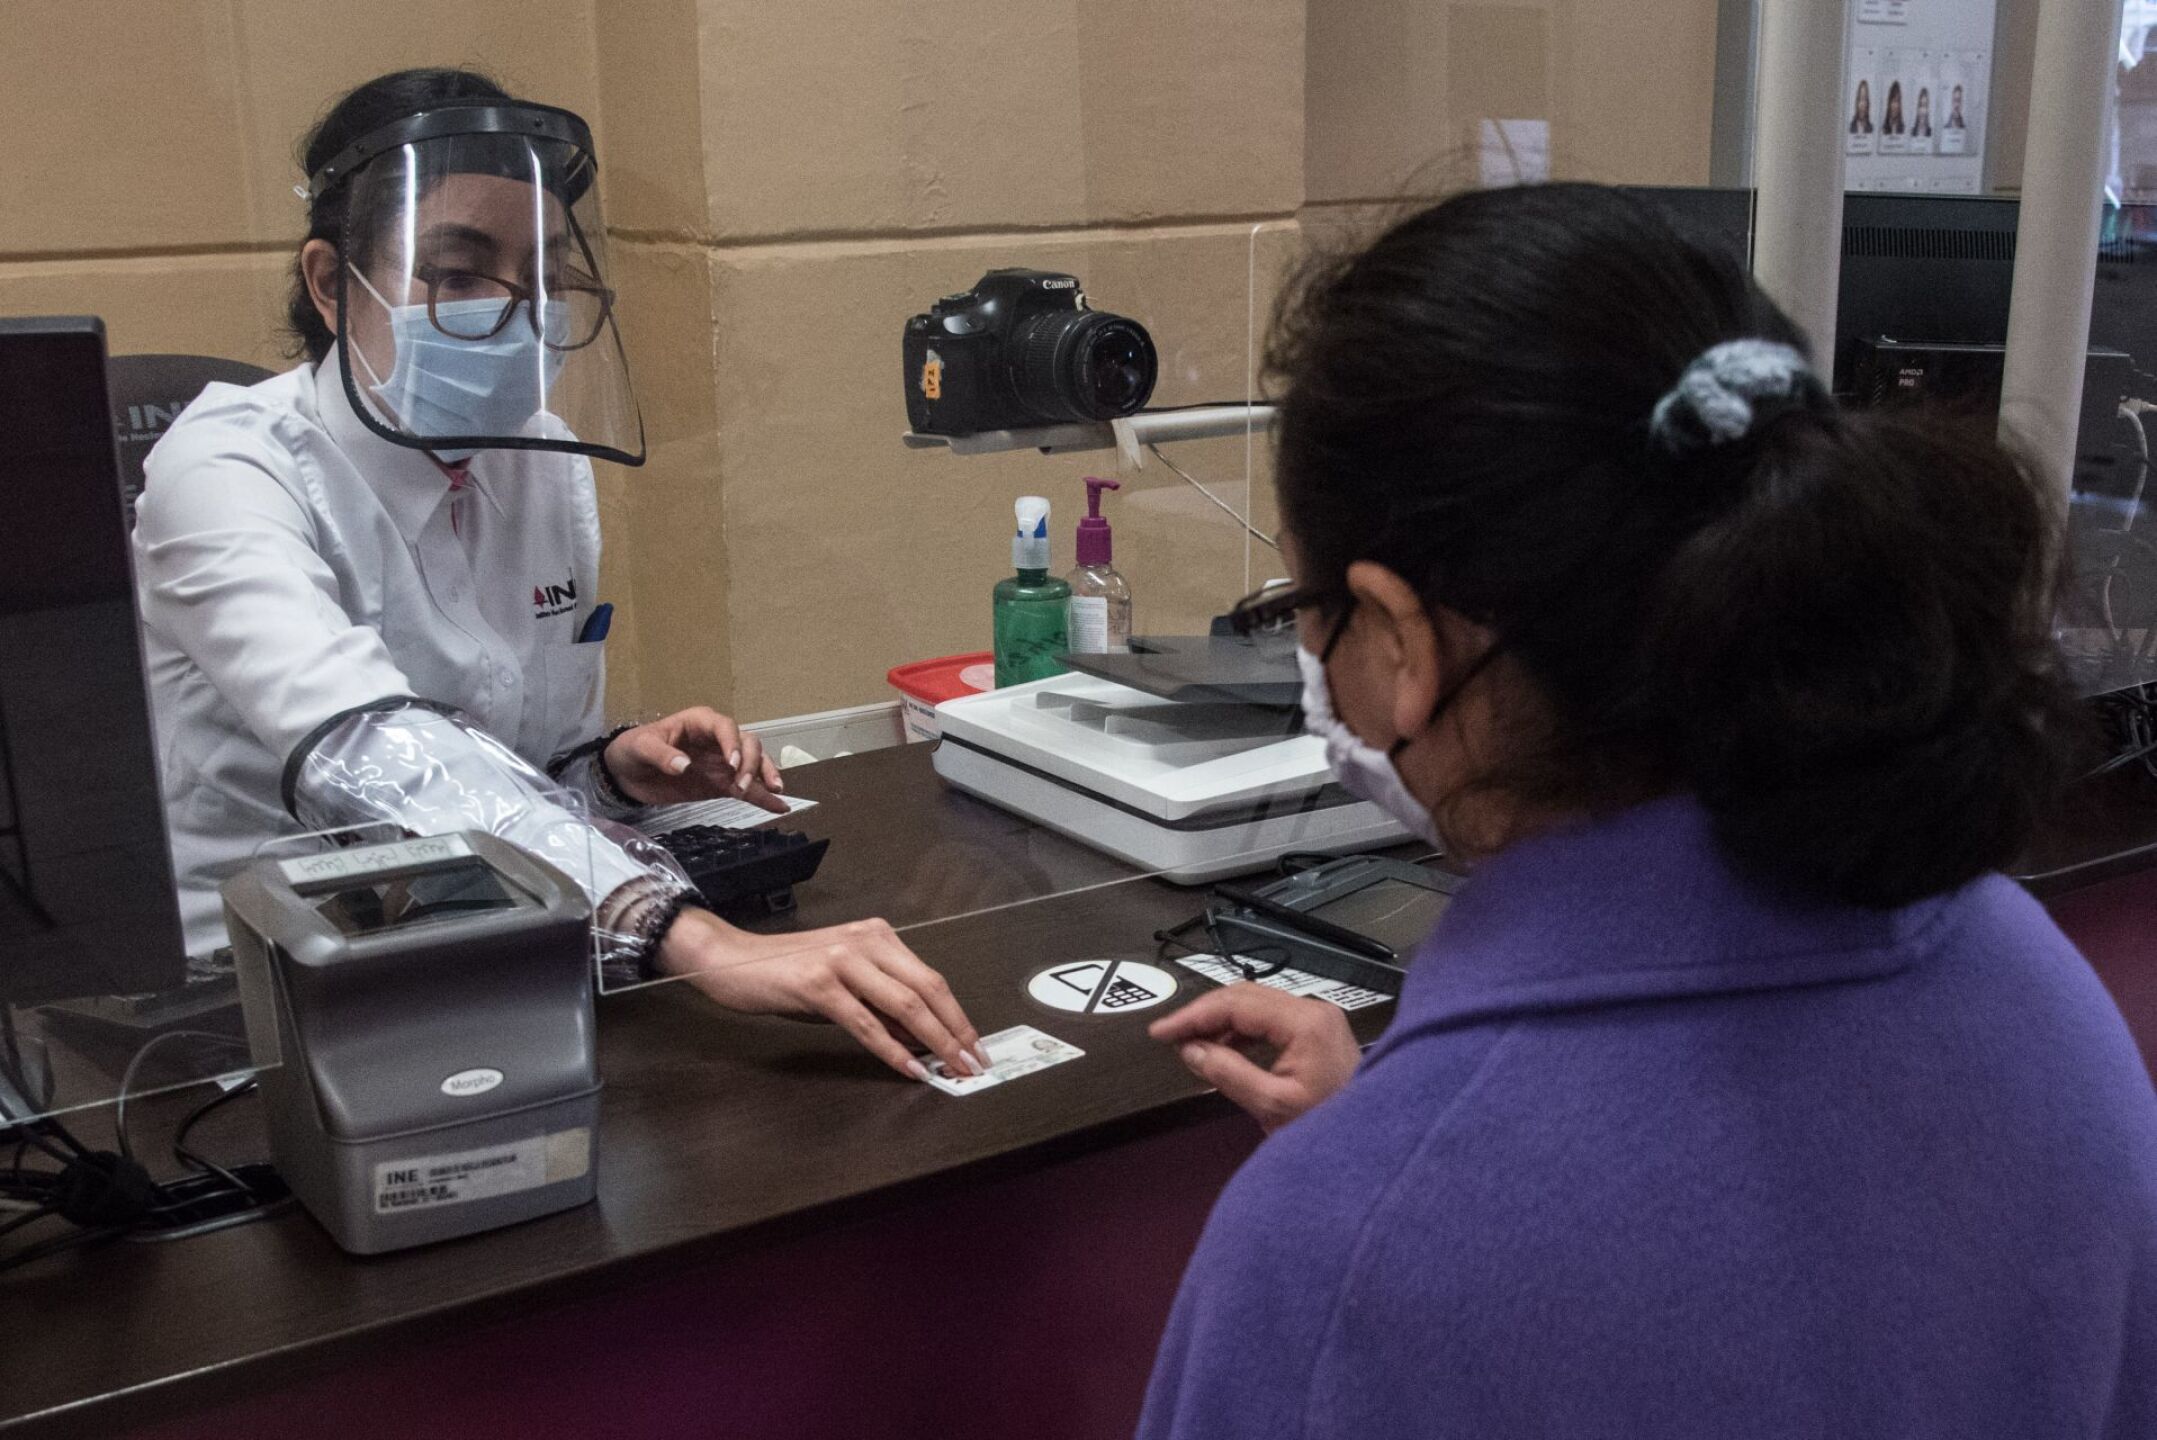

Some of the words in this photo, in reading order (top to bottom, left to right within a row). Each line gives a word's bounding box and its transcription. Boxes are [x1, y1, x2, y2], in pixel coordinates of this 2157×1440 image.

[1042, 279, 1076, 290] Canon
[1899, 368, 1917, 376] AMD
[1898, 378, 1915, 387] PRO
[128, 402, 184, 430] IN
[545, 579, 576, 607] IN
[450, 1074, 496, 1091] Morpho
[386, 1168, 419, 1186] INE
